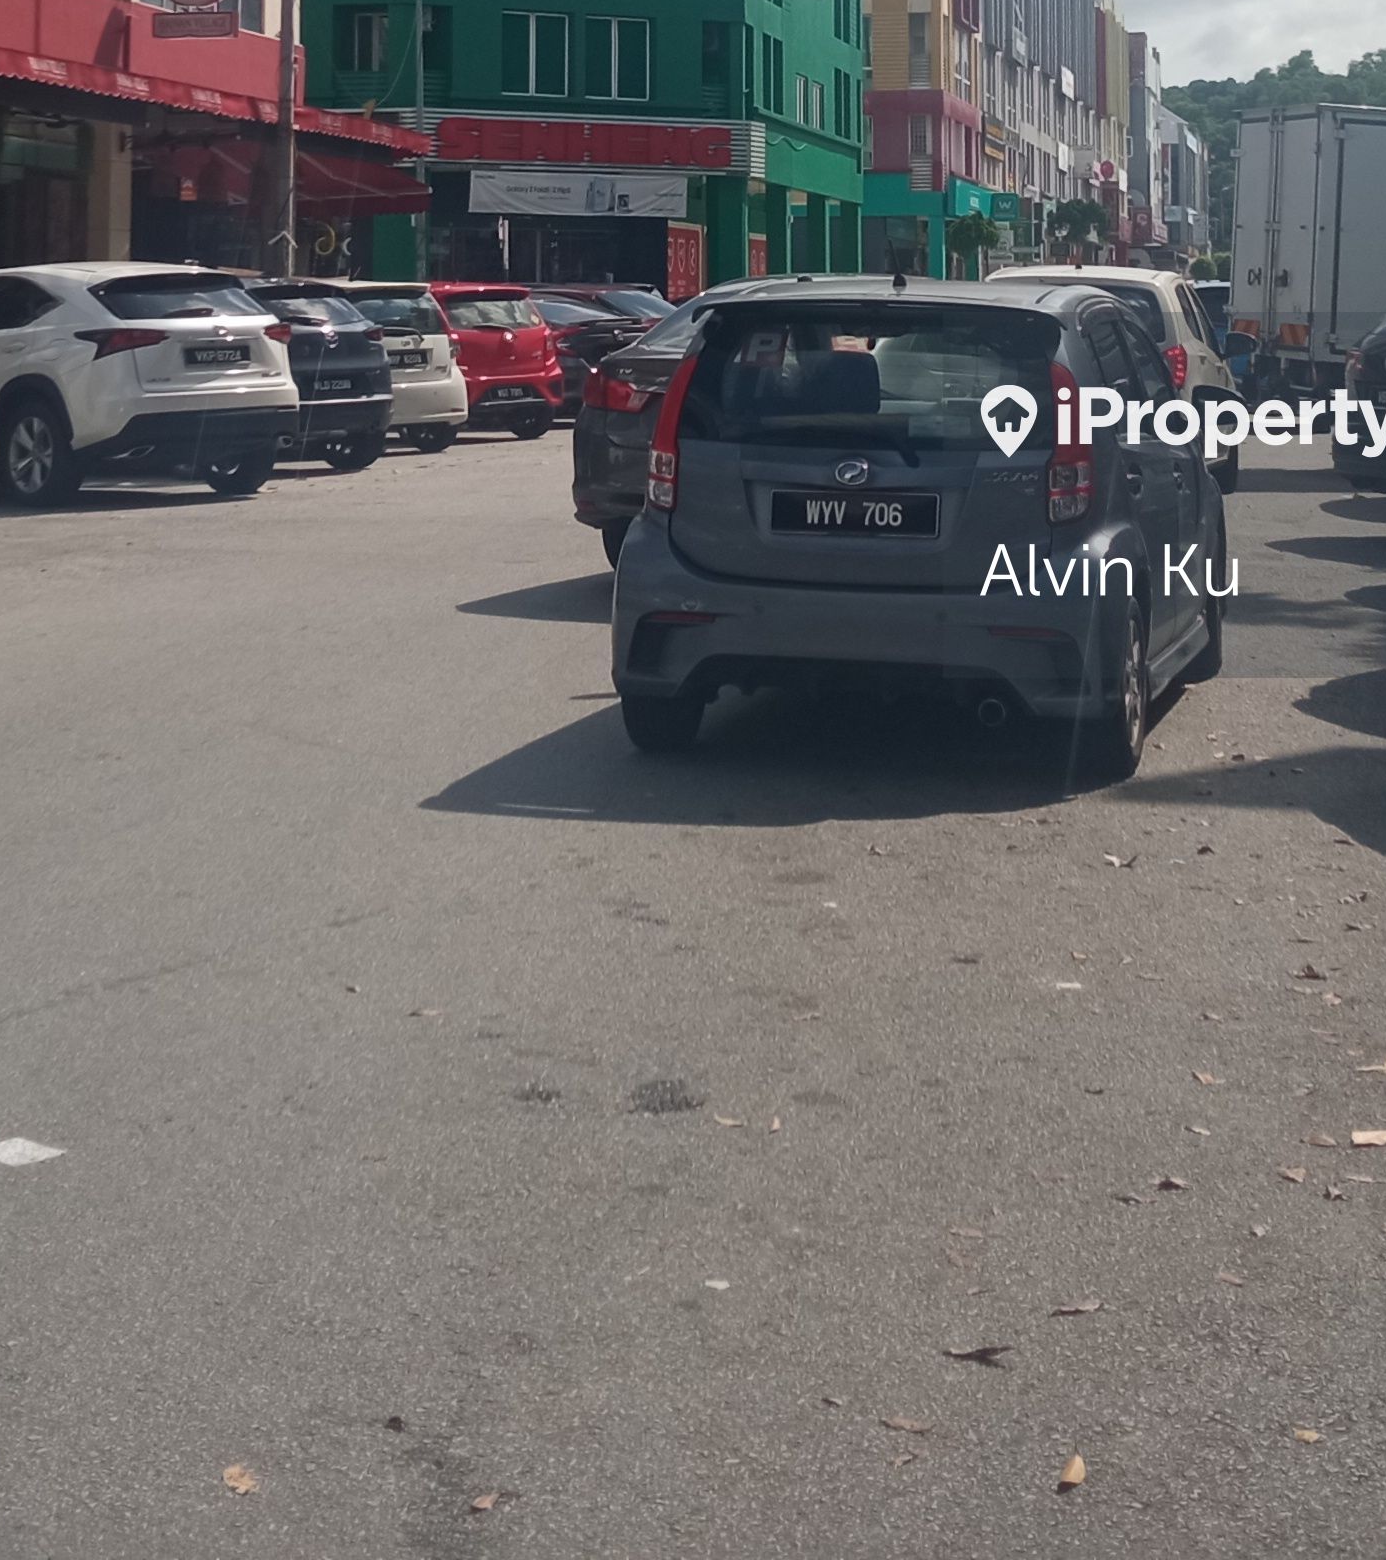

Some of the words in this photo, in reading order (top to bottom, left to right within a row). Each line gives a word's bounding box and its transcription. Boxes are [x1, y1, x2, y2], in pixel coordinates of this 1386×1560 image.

[436, 116, 732, 168] SENHENG
[806, 499, 846, 525] WYV
[863, 502, 903, 526] 706
